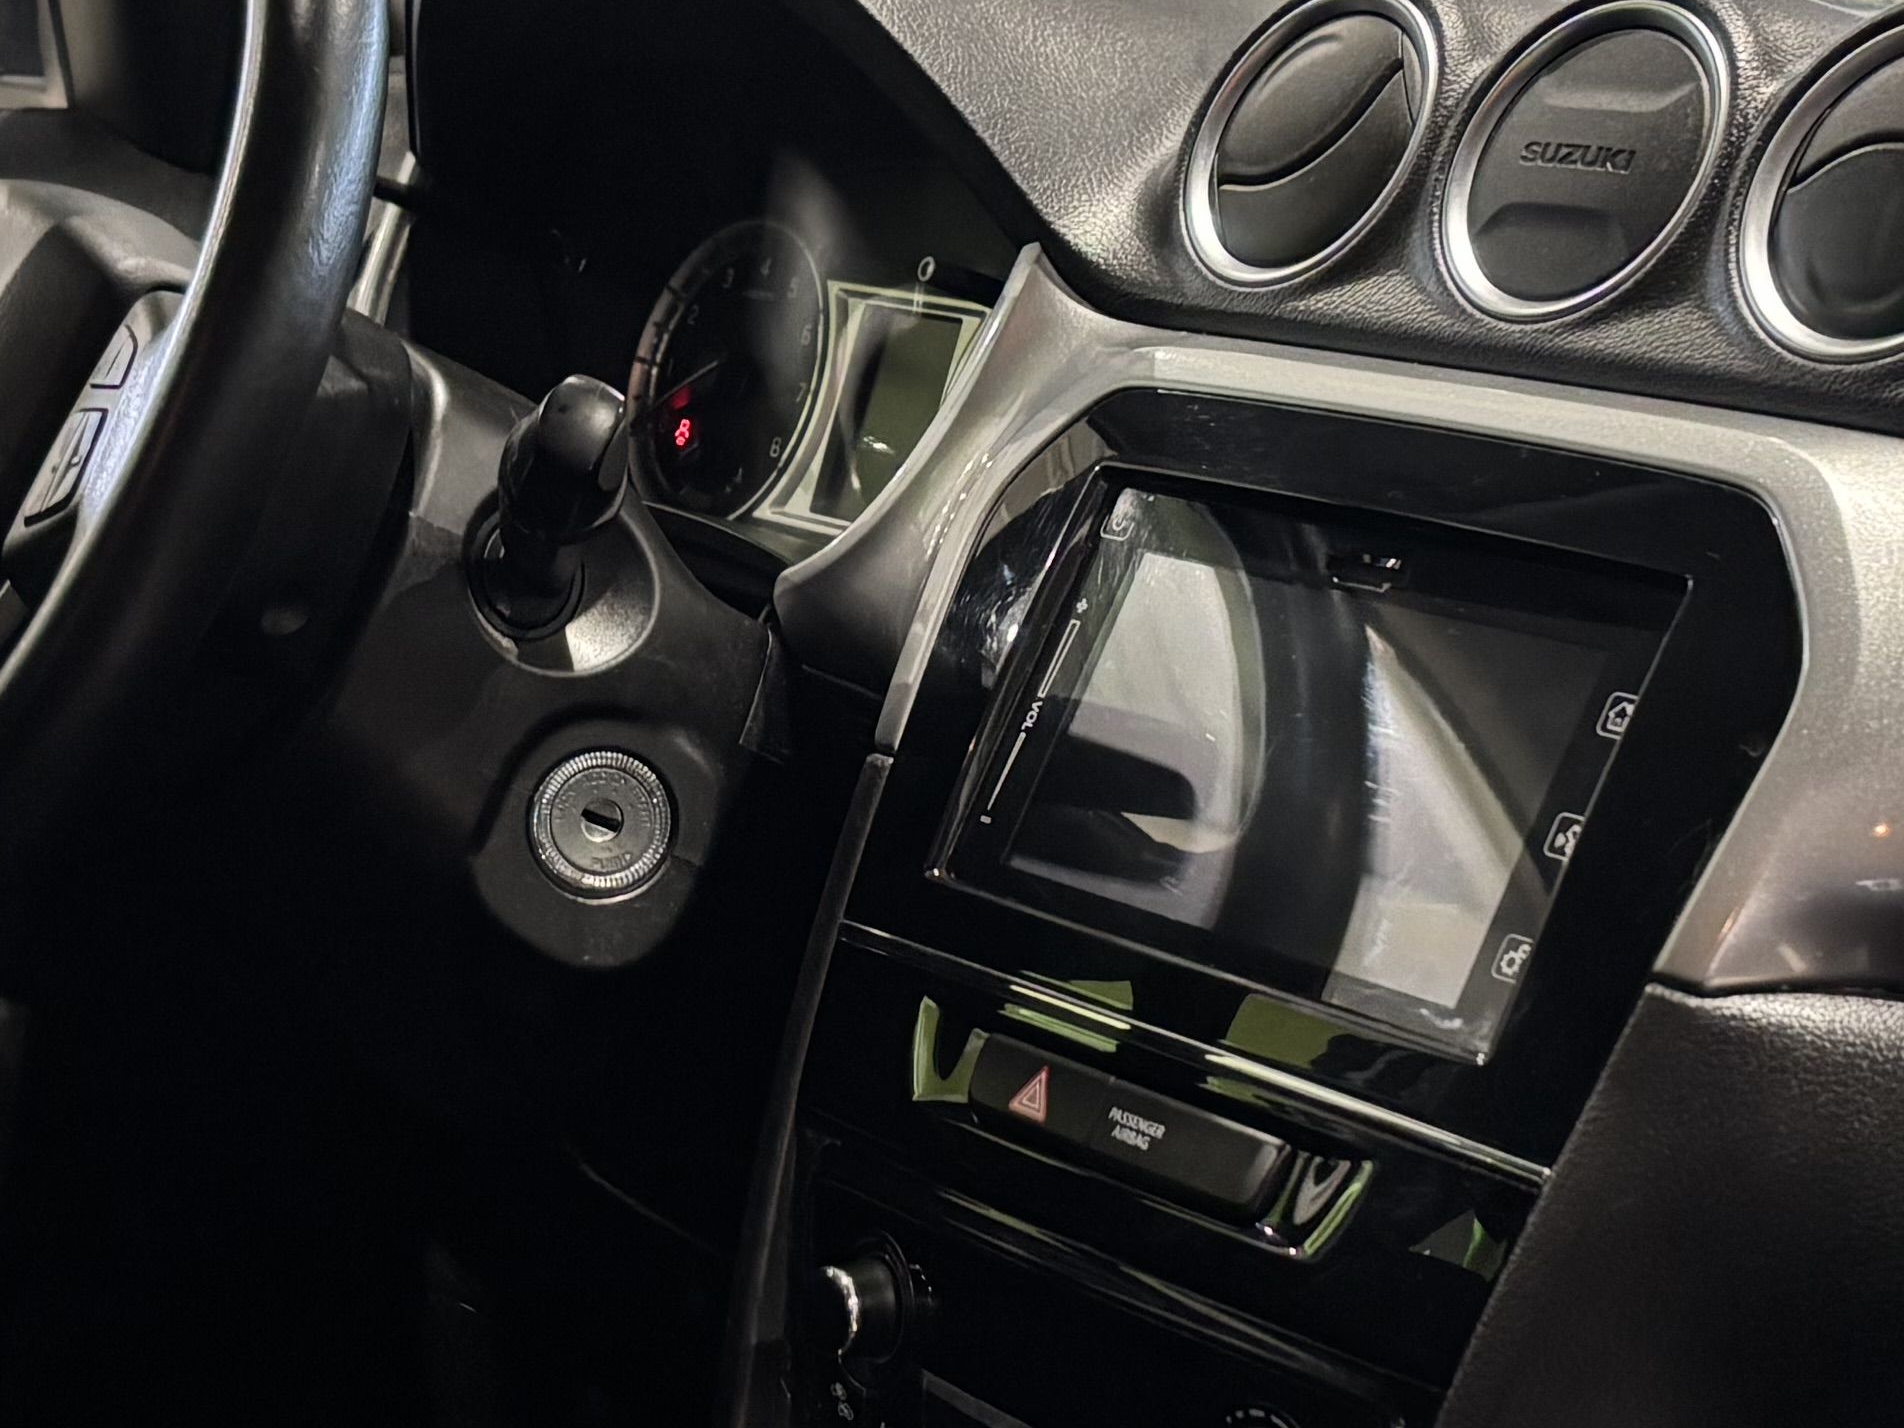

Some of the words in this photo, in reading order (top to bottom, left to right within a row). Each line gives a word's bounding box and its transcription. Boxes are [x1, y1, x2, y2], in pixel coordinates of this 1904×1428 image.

[1519, 141, 1637, 174] SUZUKI
[769, 437, 782, 458] 8
[1020, 699, 1044, 731] VOL
